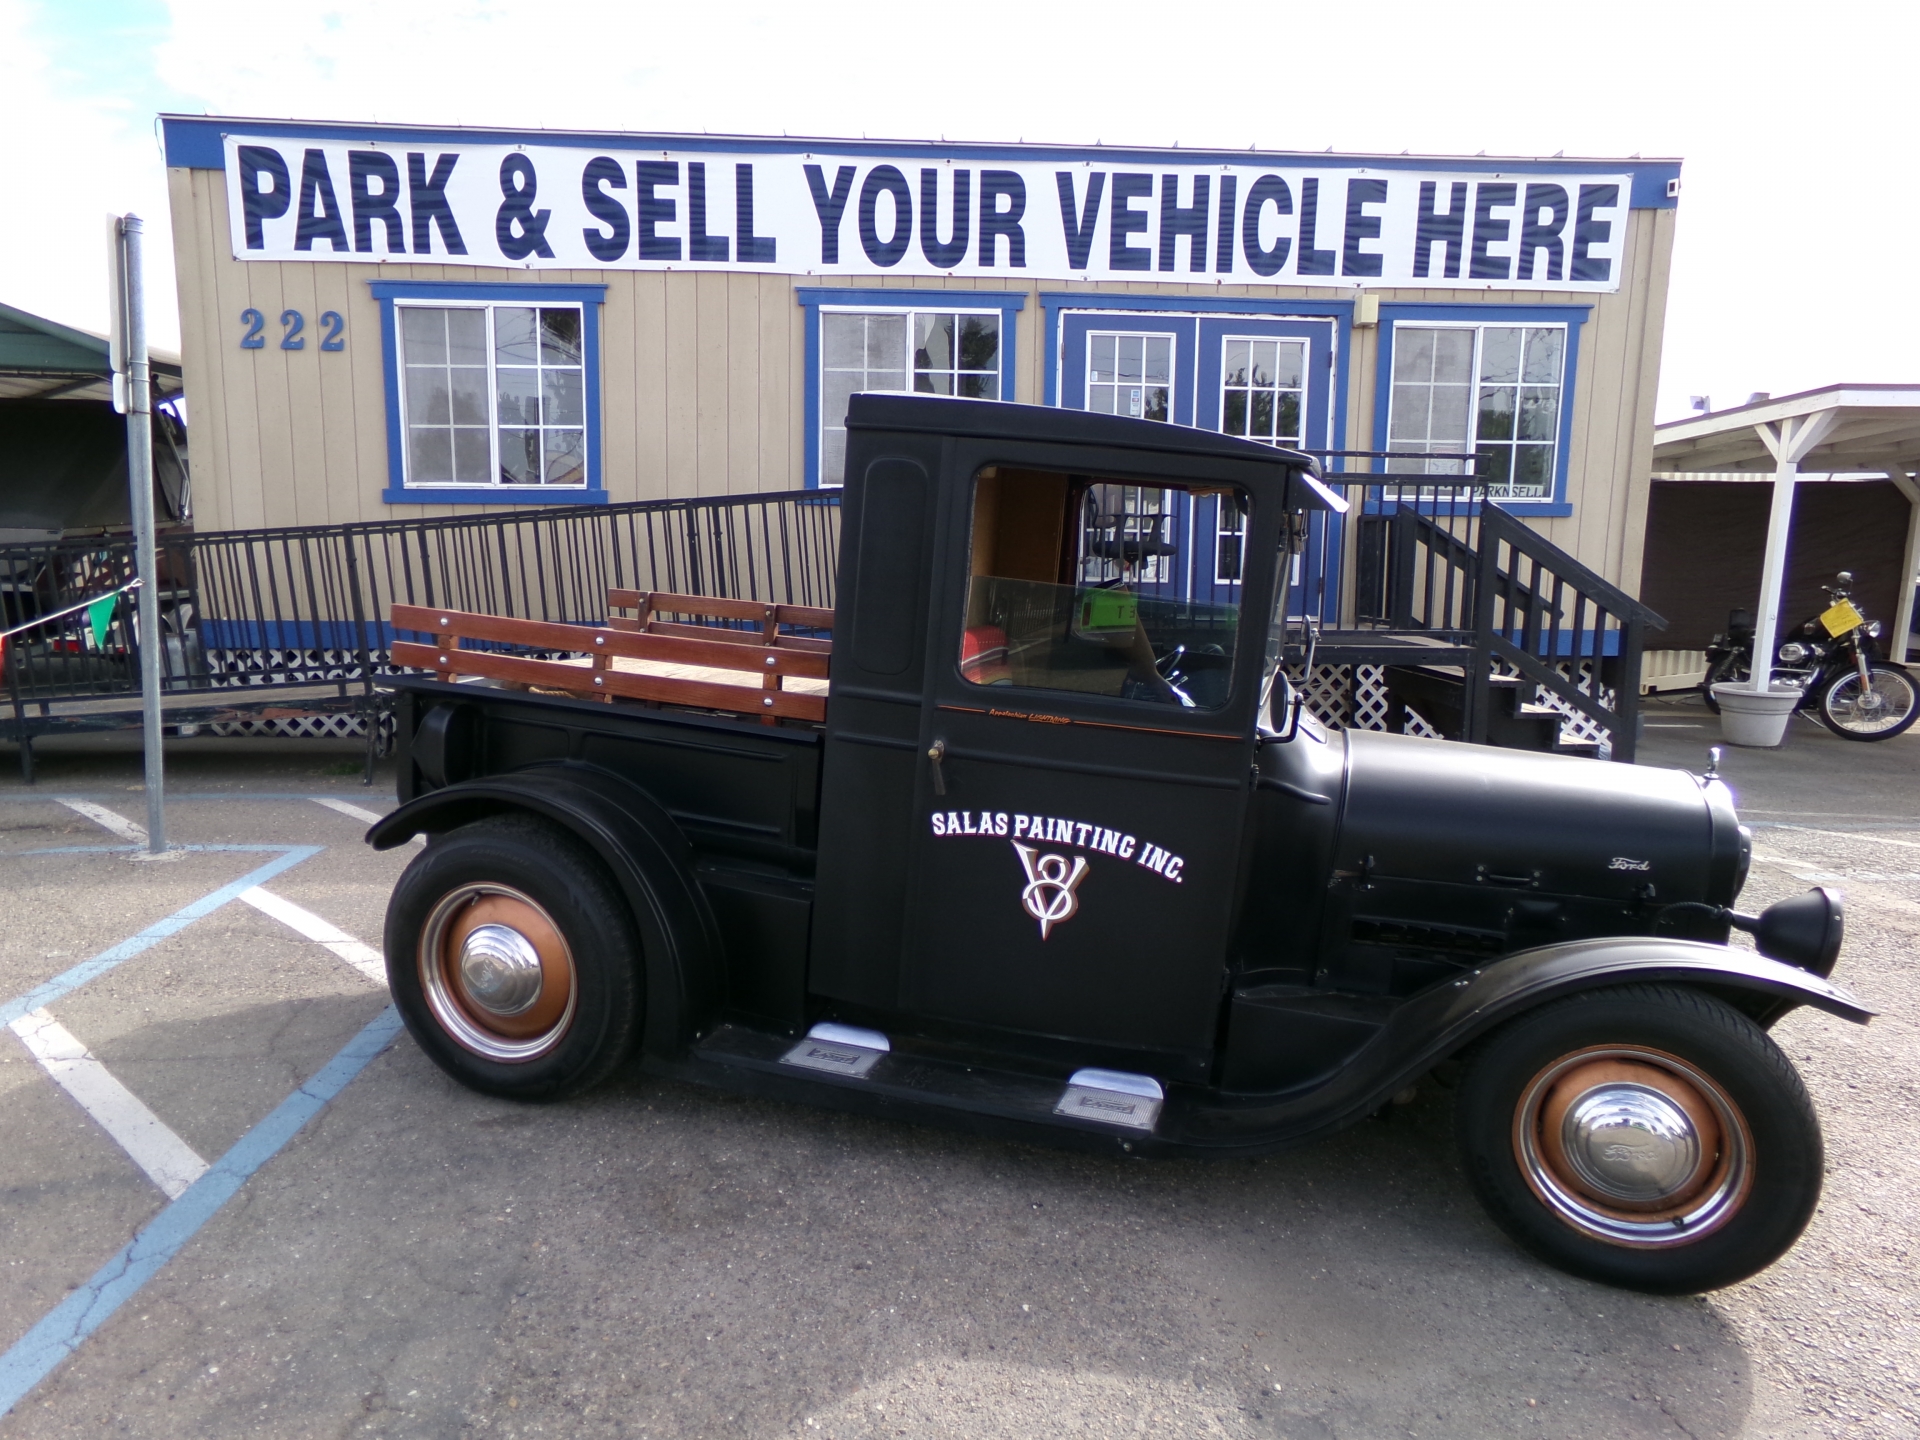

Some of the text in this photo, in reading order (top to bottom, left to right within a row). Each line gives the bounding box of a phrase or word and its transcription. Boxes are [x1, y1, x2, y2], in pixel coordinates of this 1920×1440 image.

[237, 145, 1620, 282] PARK & SELL YOUR VEHICLE HERE
[240, 308, 344, 352] 222
[931, 811, 1184, 883] SALAS PAINTING INC.
[1608, 857, 1650, 871] Ford
